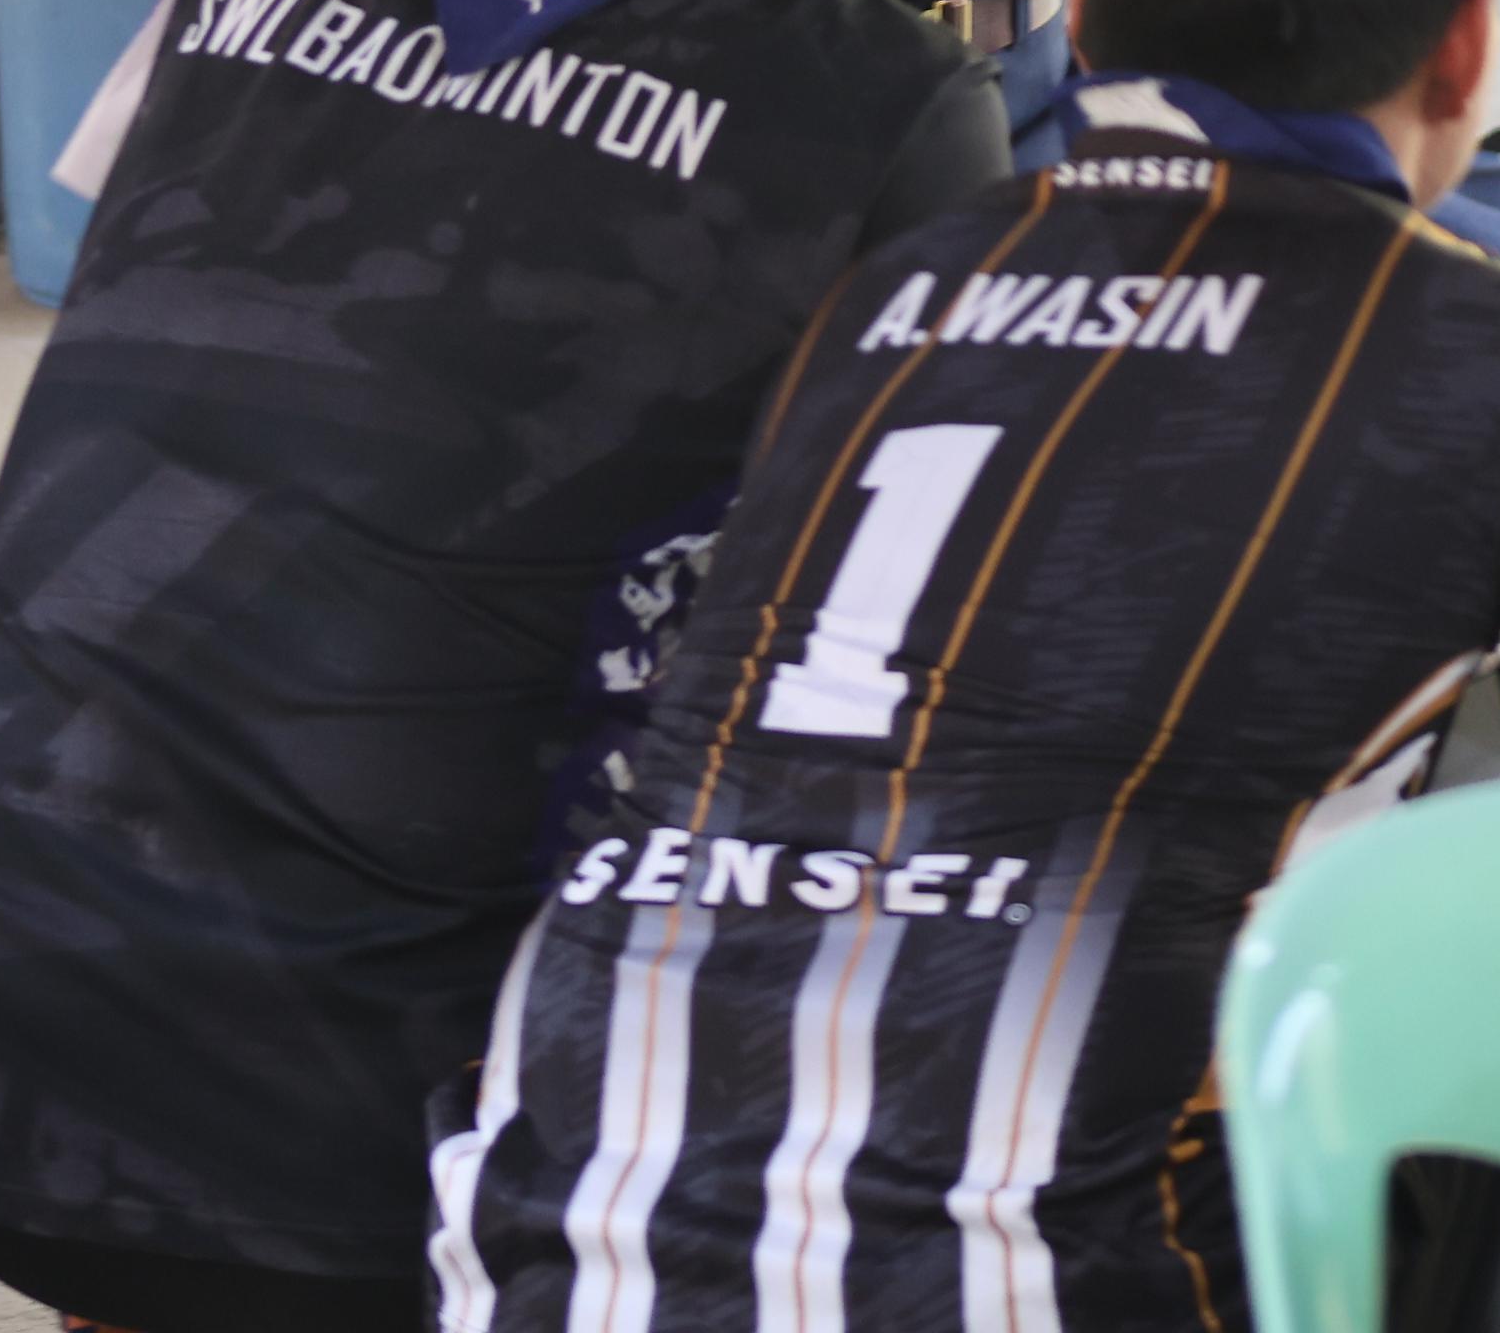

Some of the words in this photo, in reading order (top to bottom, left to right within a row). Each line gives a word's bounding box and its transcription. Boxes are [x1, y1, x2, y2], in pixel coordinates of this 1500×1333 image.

[1051, 155, 1213, 190] SENSEI
[856, 271, 1264, 355] A.WASIN
[758, 423, 1005, 737] 1
[560, 827, 1029, 919] SENSEI
